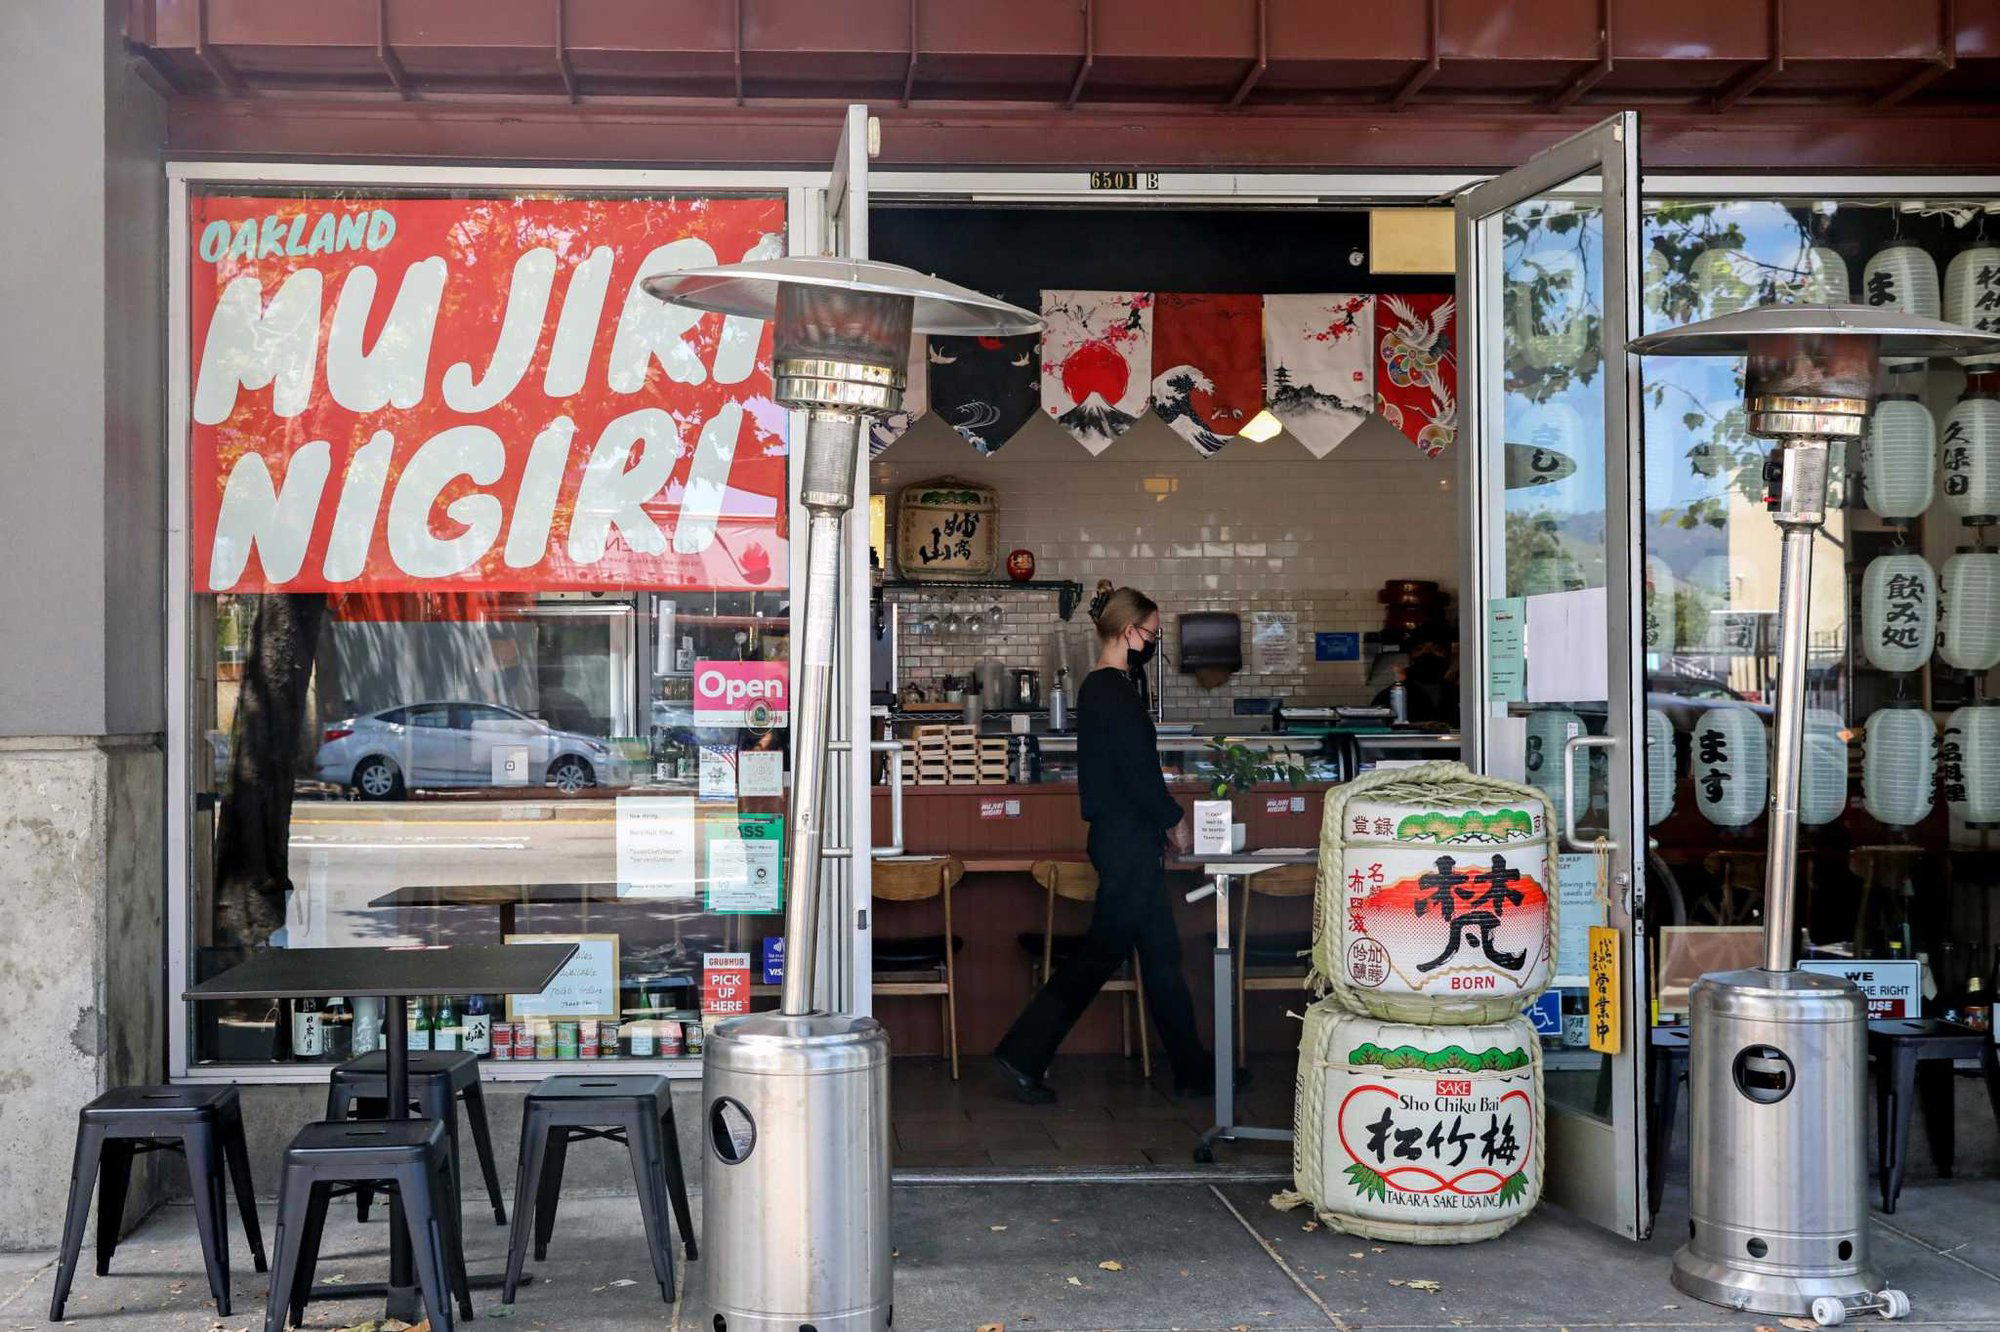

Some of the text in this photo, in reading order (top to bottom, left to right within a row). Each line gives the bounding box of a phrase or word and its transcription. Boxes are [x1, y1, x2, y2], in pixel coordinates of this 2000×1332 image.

[1091, 172, 1158, 189] 6501 B
[200, 209, 397, 263] OAKLAND
[207, 401, 743, 590] NIGIRI
[1882, 573, 1926, 649] 飲み処
[698, 670, 783, 705] Open
[1700, 729, 1732, 803] ます
[725, 825, 765, 838] PASS
[1352, 815, 1395, 837] 登録
[709, 957, 744, 966] GRUBHUB
[711, 975, 741, 985] PICK
[1451, 976, 1496, 990] BORN
[1845, 972, 1874, 981] WE
[718, 987, 735, 998] UP
[1880, 986, 1910, 996] RIGHT
[710, 1001, 743, 1011] HERE
[1867, 1001, 1893, 1011] USE
[1437, 1083, 1471, 1096] SAKE
[1399, 1095, 1500, 1115] Sho Chiku Bai
[1365, 1106, 1521, 1167] 松竹梅
[1386, 1190, 1431, 1208] TAKARA
[1433, 1194, 1459, 1209] SAKE
[1461, 1195, 1482, 1209] USA
